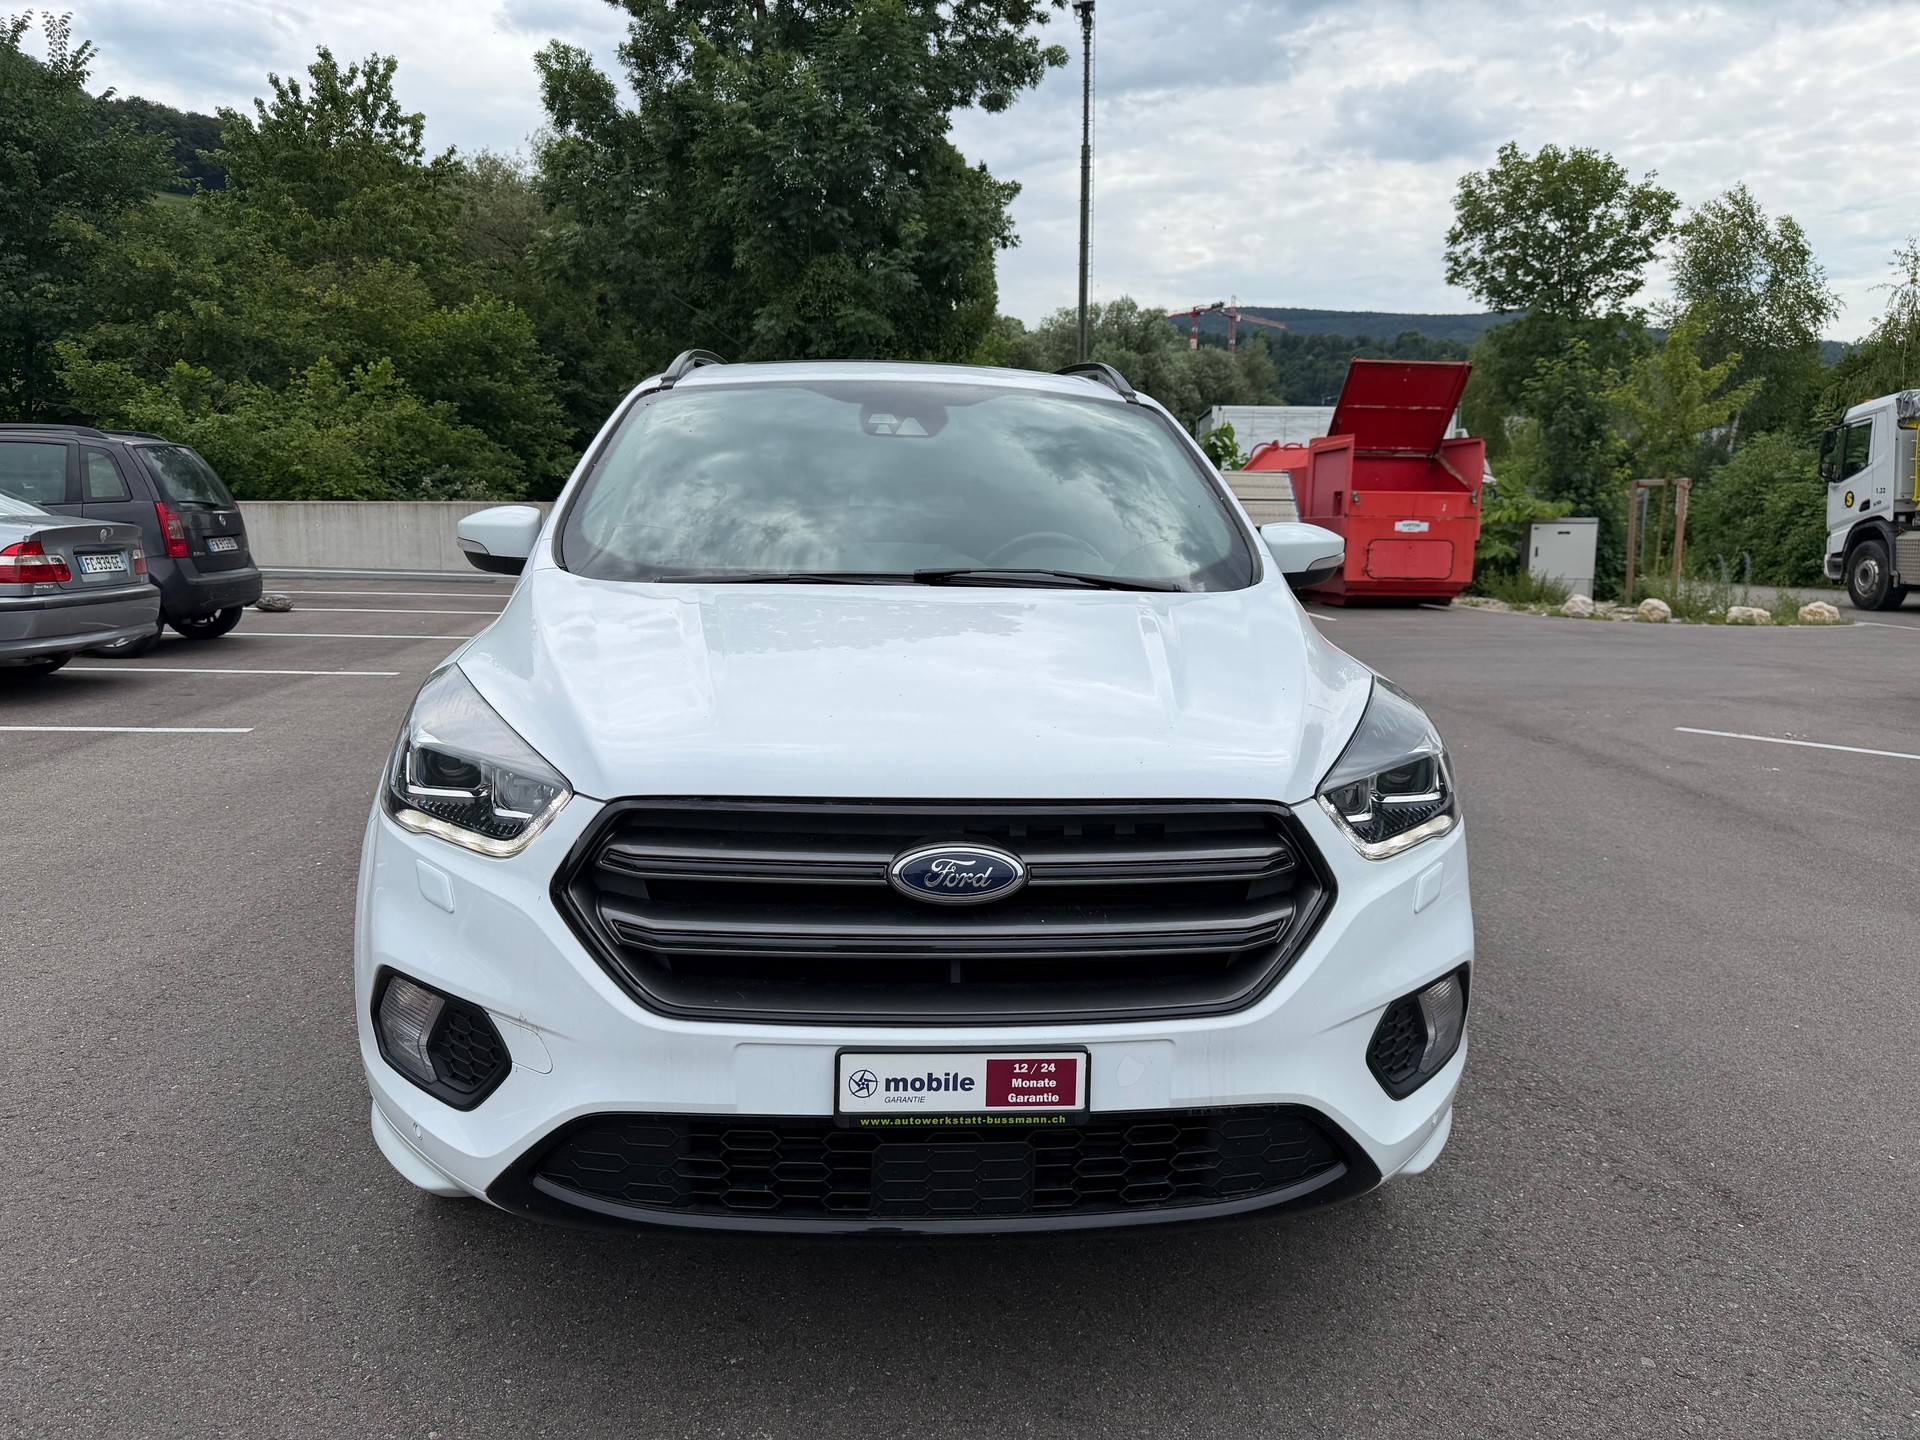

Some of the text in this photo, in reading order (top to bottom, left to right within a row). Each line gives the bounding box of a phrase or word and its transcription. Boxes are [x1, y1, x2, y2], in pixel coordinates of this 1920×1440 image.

[1846, 492, 1853, 506] S
[924, 858, 994, 888] Ford
[1013, 1063, 1056, 1074] 12 / 24
[884, 1072, 975, 1092] mobile
[1011, 1078, 1057, 1088] Monate
[884, 1096, 926, 1104] GARANTIE
[1007, 1093, 1060, 1103] Garantie
[860, 1115, 1066, 1126] www.autowerkstatt-bussmann.ch
